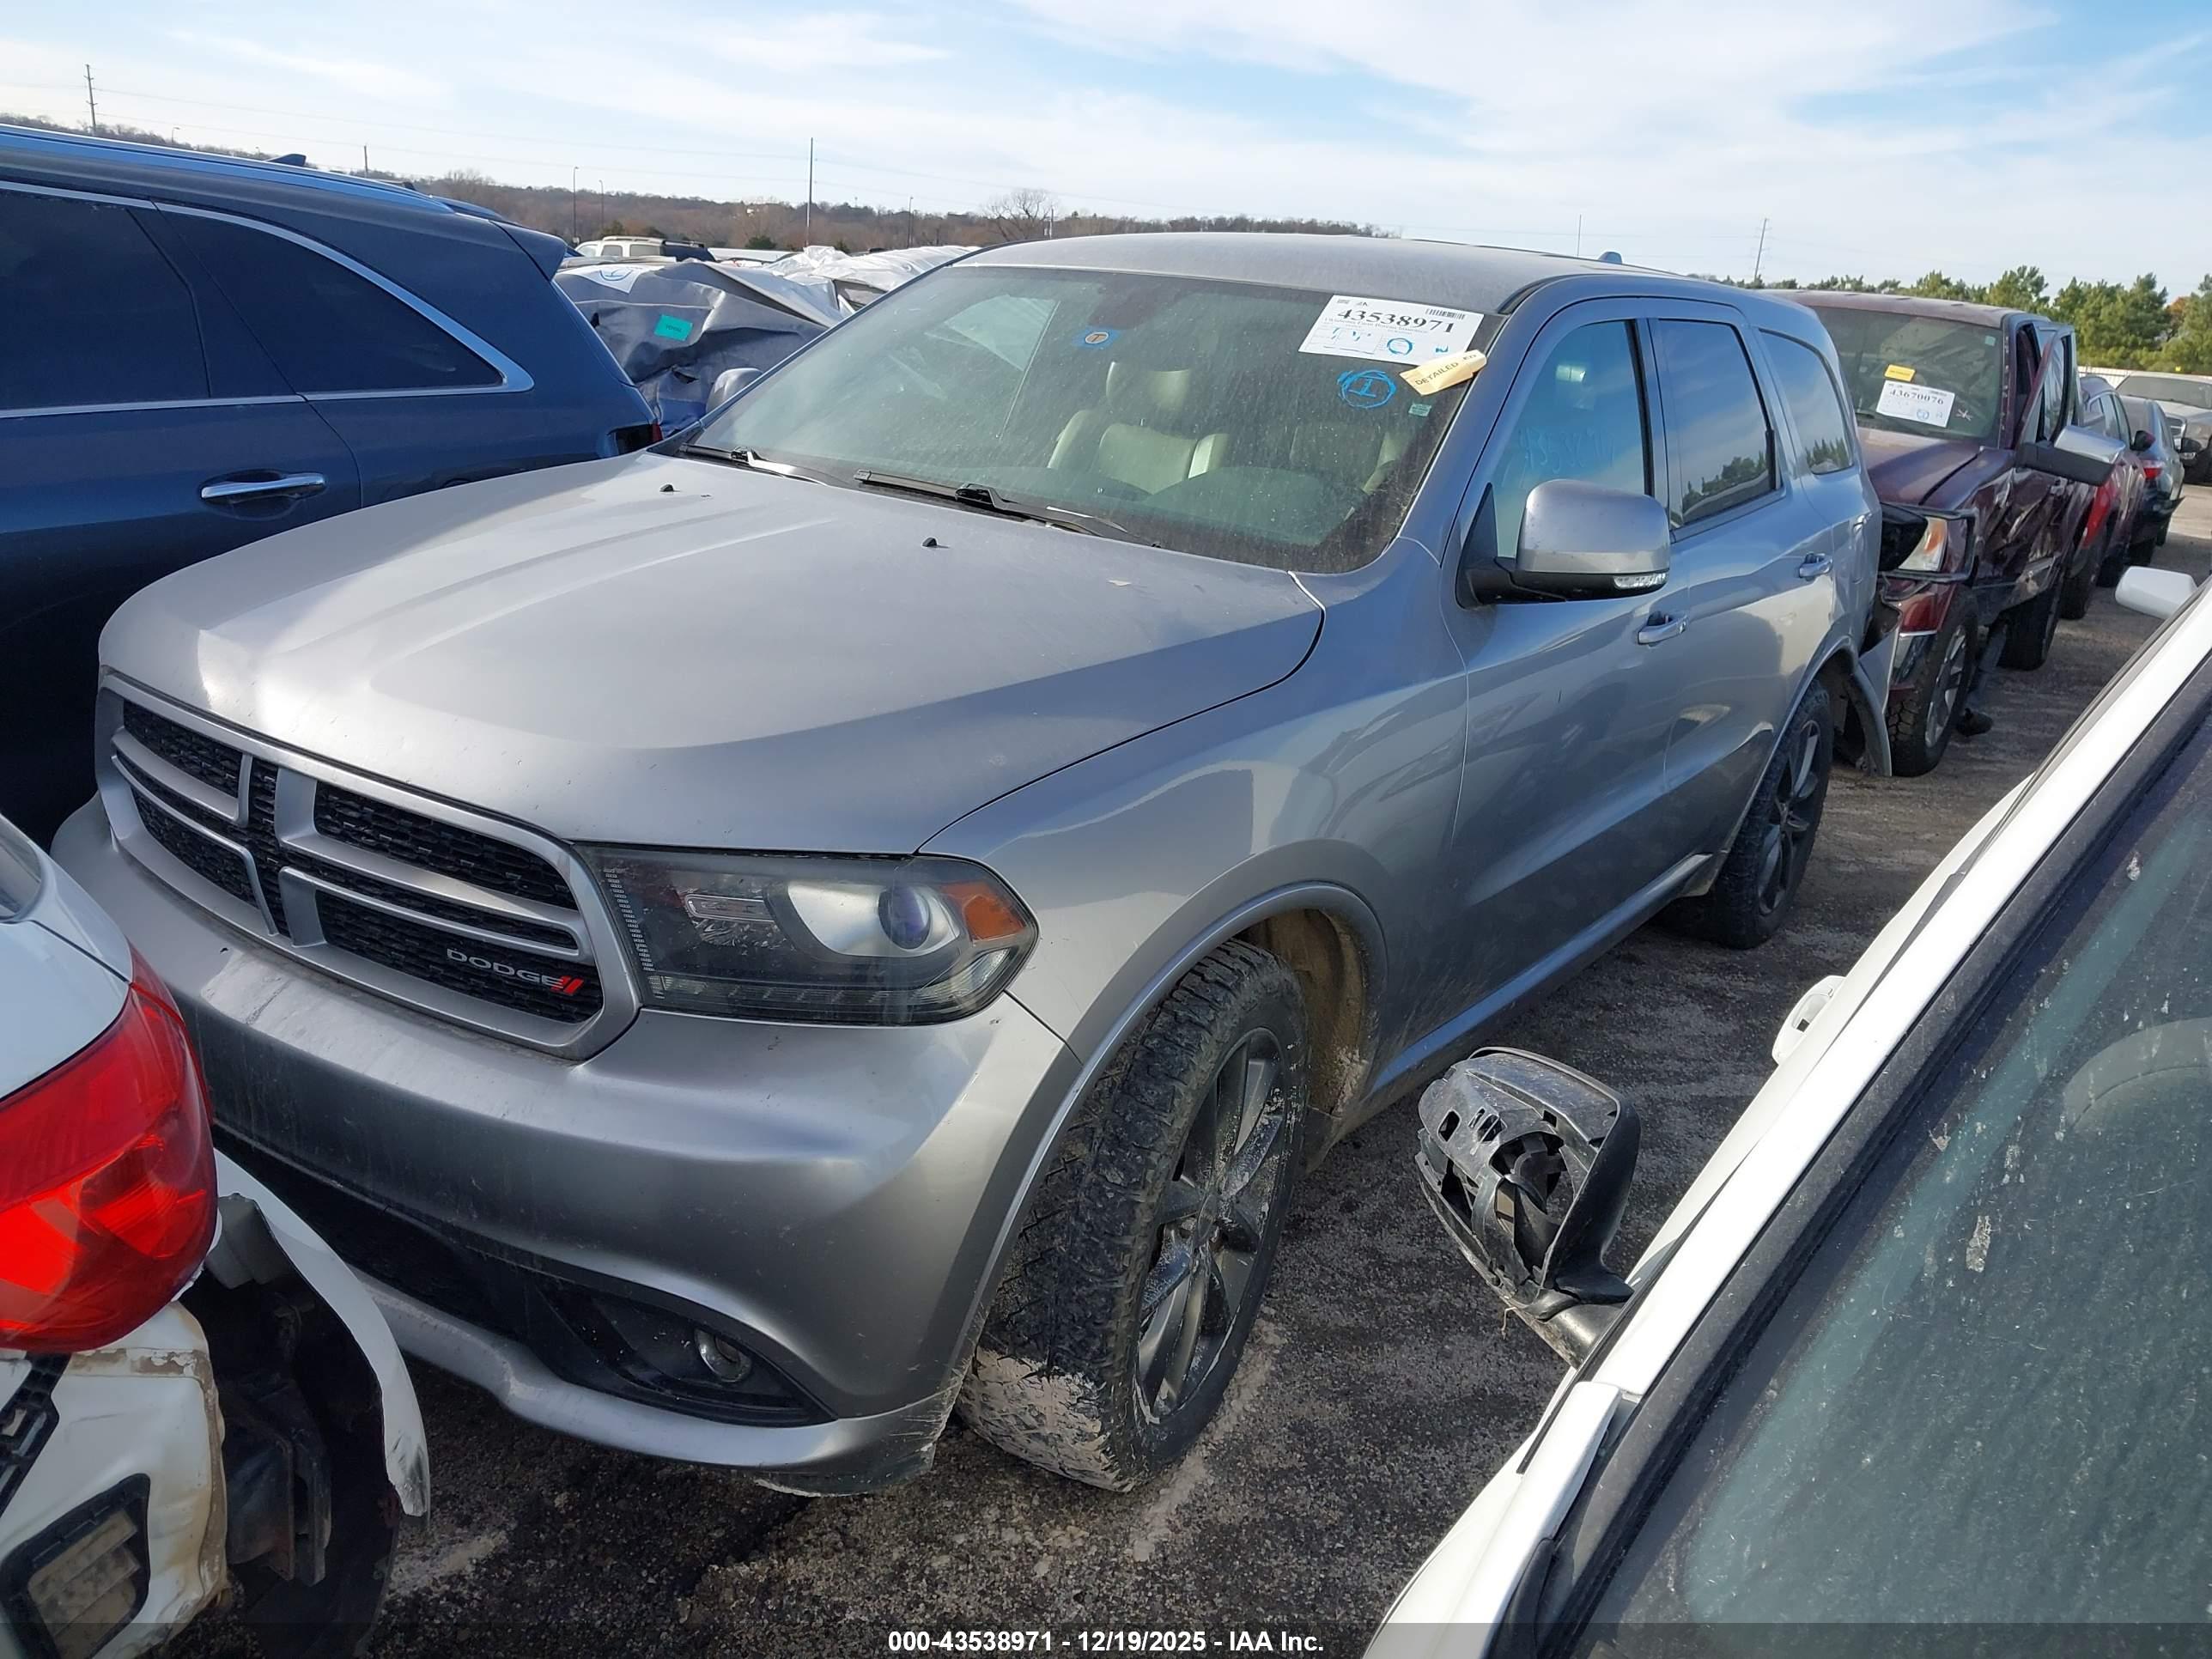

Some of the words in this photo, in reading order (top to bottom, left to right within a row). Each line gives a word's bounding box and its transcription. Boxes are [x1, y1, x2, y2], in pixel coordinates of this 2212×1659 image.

[1337, 309, 1455, 333] 43538971
[1415, 362, 1459, 386] DETAILED
[447, 948, 564, 989] DODGE
